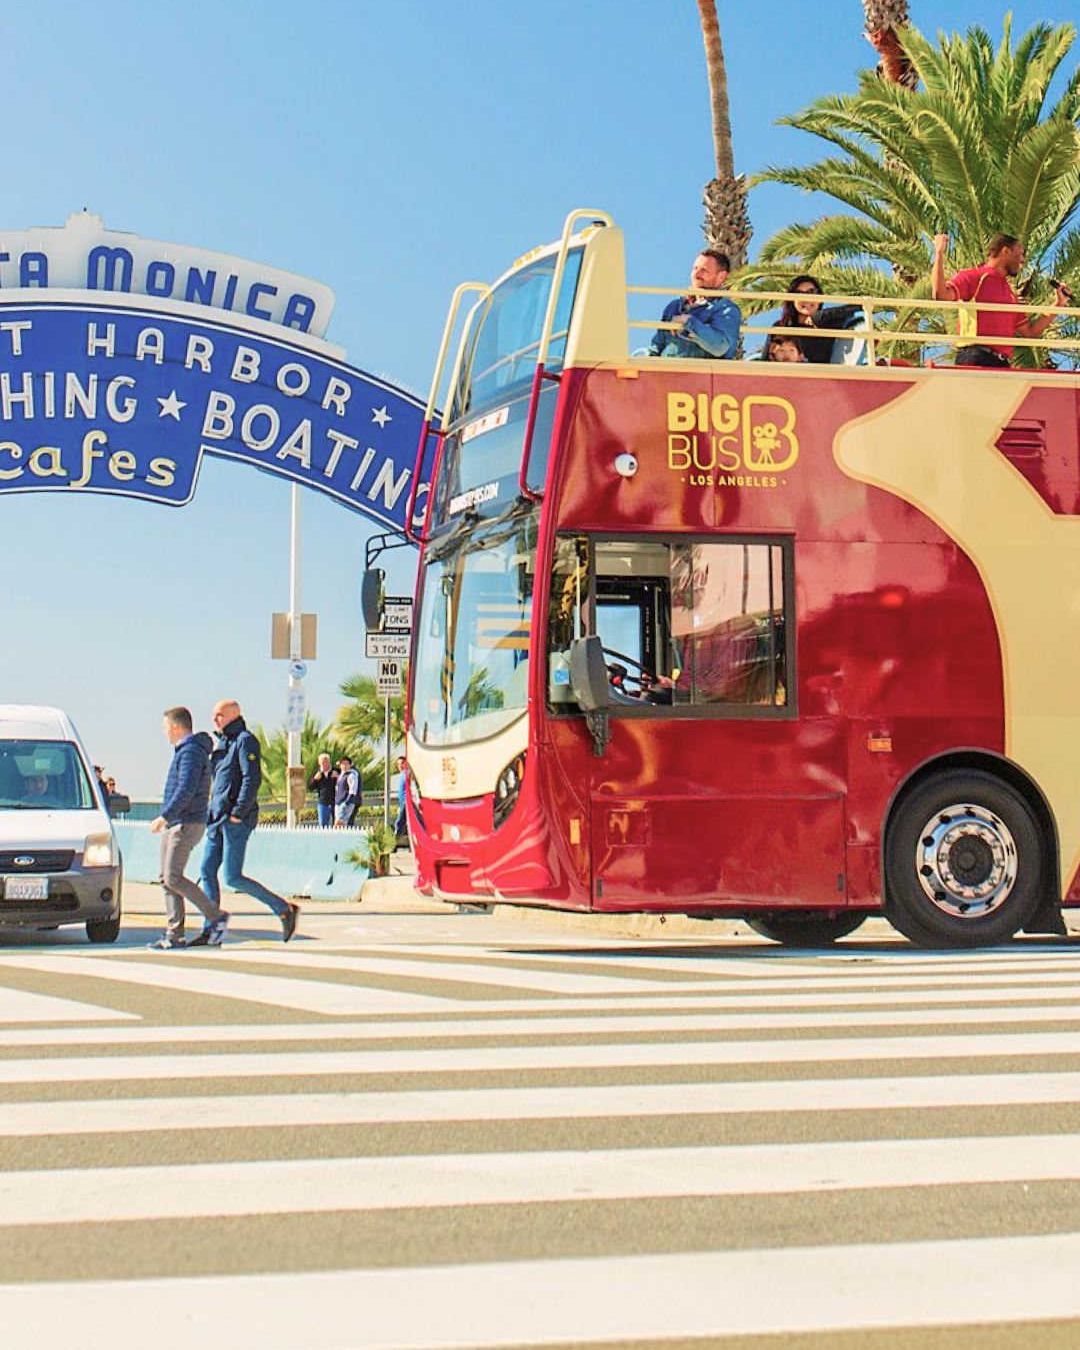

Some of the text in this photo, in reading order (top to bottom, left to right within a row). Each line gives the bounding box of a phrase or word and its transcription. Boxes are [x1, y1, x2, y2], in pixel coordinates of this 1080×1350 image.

[86, 246, 316, 333] MONICA
[87, 322, 353, 417] HARBOR
[667, 392, 740, 433] BIG
[0, 372, 431, 527] HING BOATING
[668, 434, 741, 471] BUS
[689, 475, 777, 488] LOS ANGELES
[372, 645, 407, 654] 3 TONS
[382, 663, 397, 675] NO
